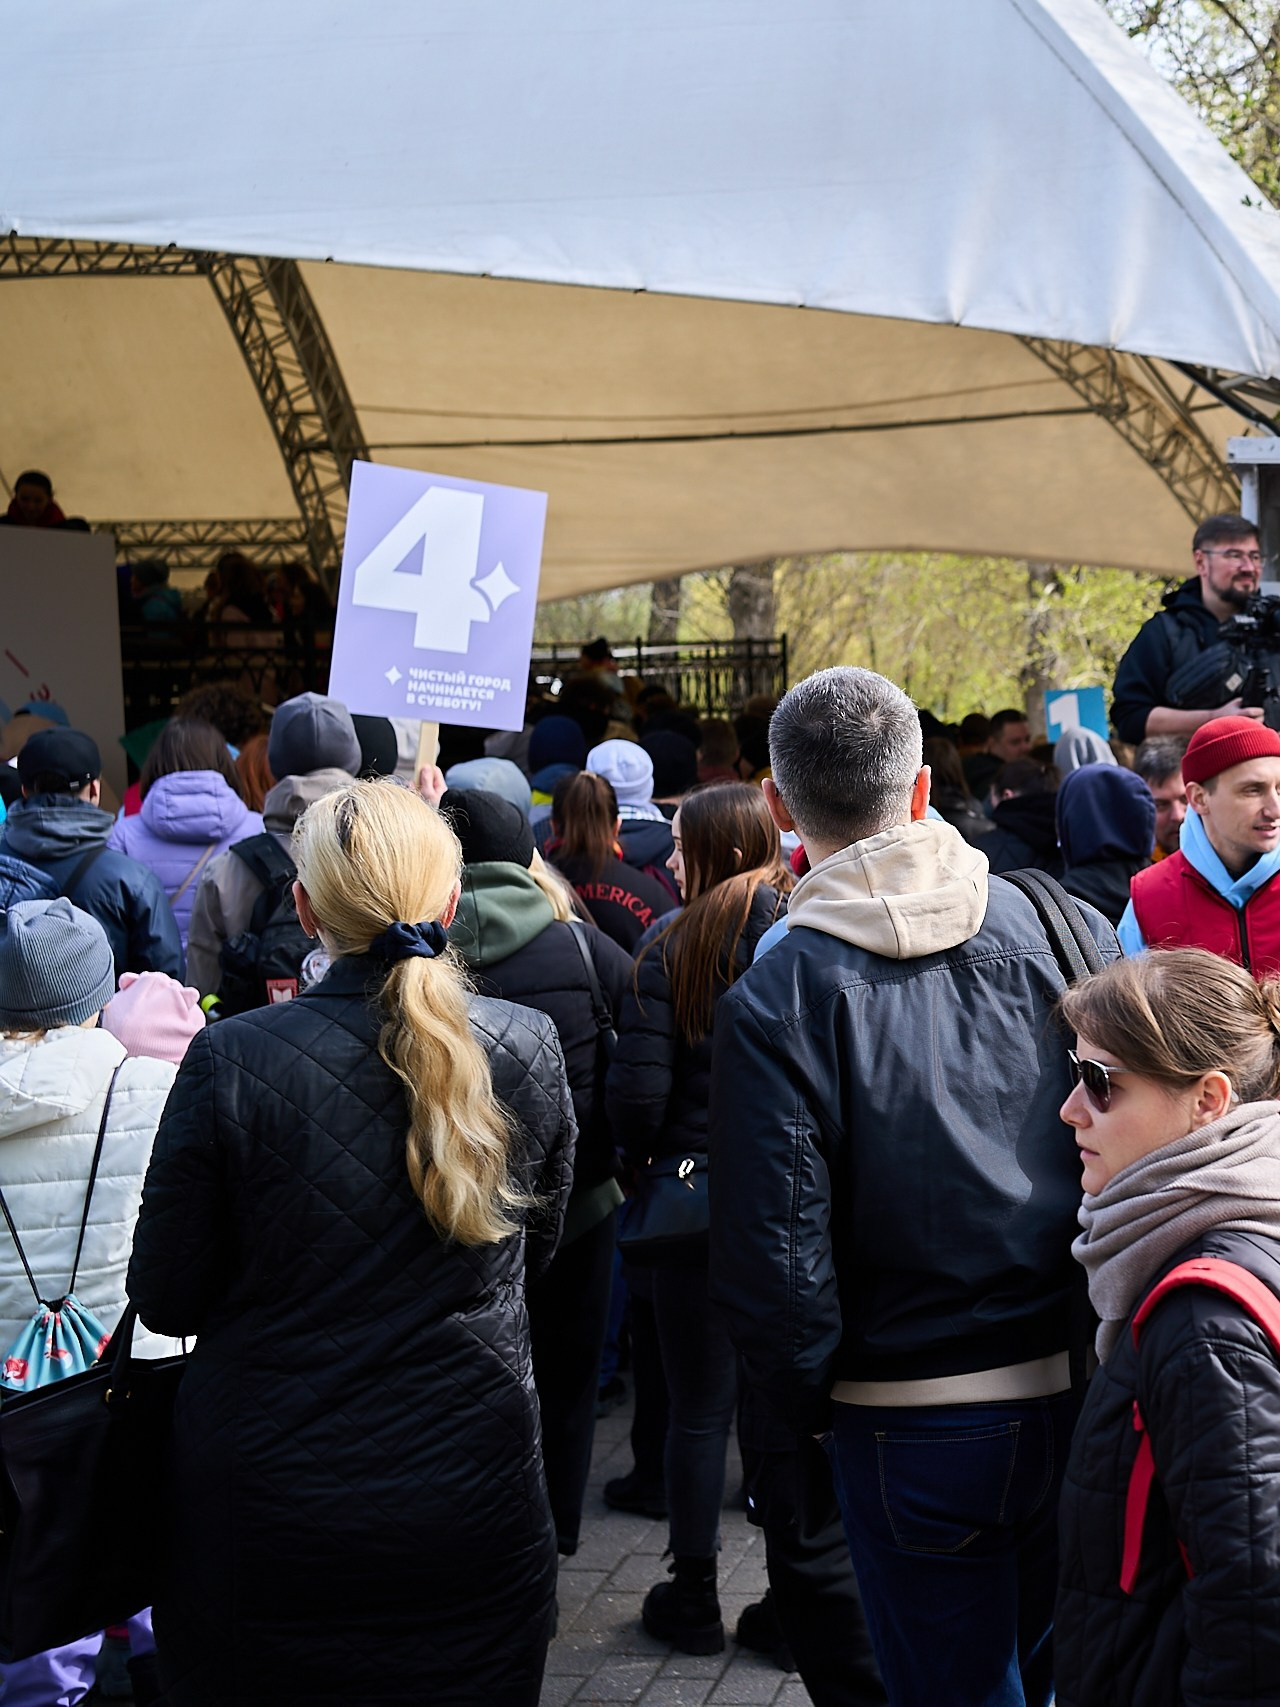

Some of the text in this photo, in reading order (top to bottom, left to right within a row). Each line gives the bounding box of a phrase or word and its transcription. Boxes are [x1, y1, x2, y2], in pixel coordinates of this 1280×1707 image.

[353, 487, 490, 654] 4
[407, 680, 495, 701] НАЧИНАЕТСЯ
[409, 667, 512, 692] ЧИСТЫЙ ГОРОД
[406, 693, 482, 712] В СУББОТУ!
[1048, 692, 1080, 735] 1
[575, 882, 657, 930] MERICA
